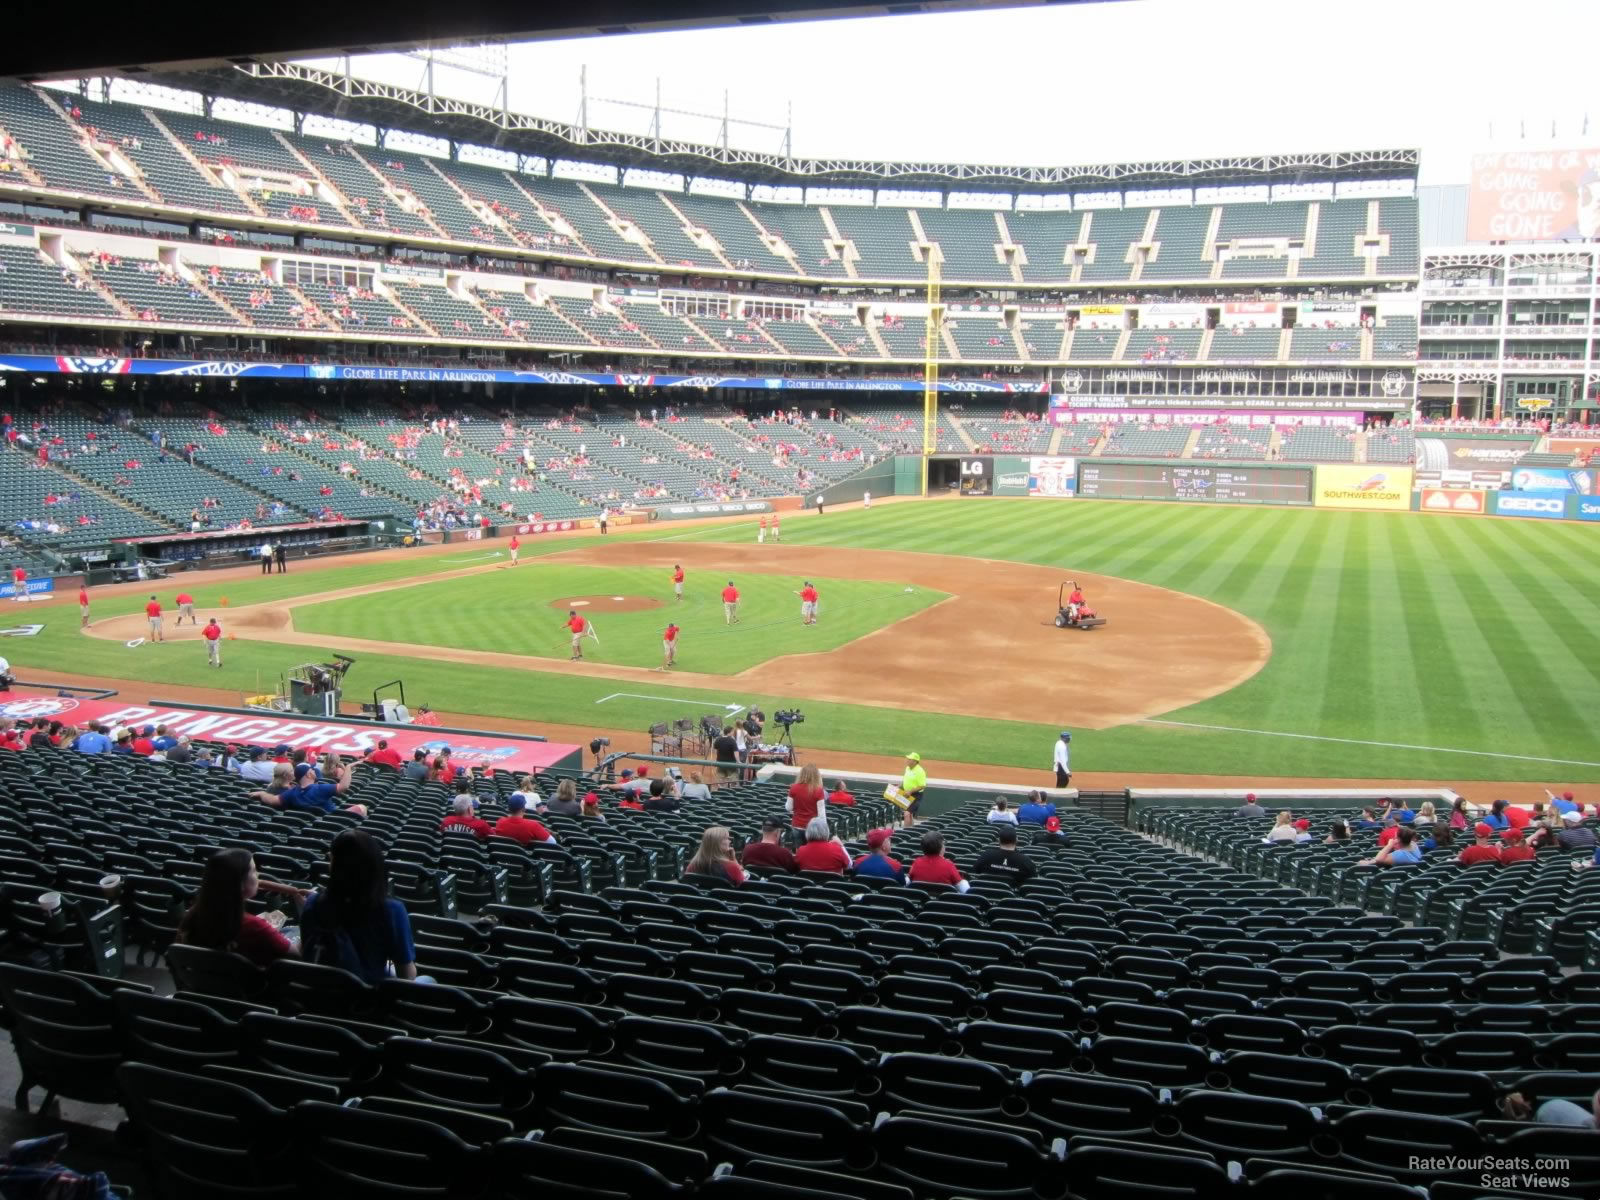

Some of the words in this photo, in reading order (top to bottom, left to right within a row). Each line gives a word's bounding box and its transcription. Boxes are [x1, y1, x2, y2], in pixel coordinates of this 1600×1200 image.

[1480, 171, 1538, 191] GOING
[1499, 192, 1564, 212] GOING
[1489, 213, 1554, 238] GONE
[343, 368, 376, 379] GLOBE
[379, 369, 399, 380] LIFE
[401, 370, 426, 381] PARK
[442, 372, 496, 382] ARLINGTON
[1106, 370, 1128, 380] JACK
[1196, 370, 1219, 381] JACK
[1290, 370, 1314, 381] JACK
[786, 380, 809, 389] GLOBE
[811, 381, 825, 389] LIFE
[827, 381, 844, 389] PARK
[855, 382, 902, 390] ARLINGTON
[961, 461, 983, 475] LG
[1193, 468, 1210, 476] 6:10
[1324, 490, 1400, 500] SOUTHWEST.COM
[1498, 496, 1563, 512] GEICO
[81, 707, 398, 752] RANGERS
